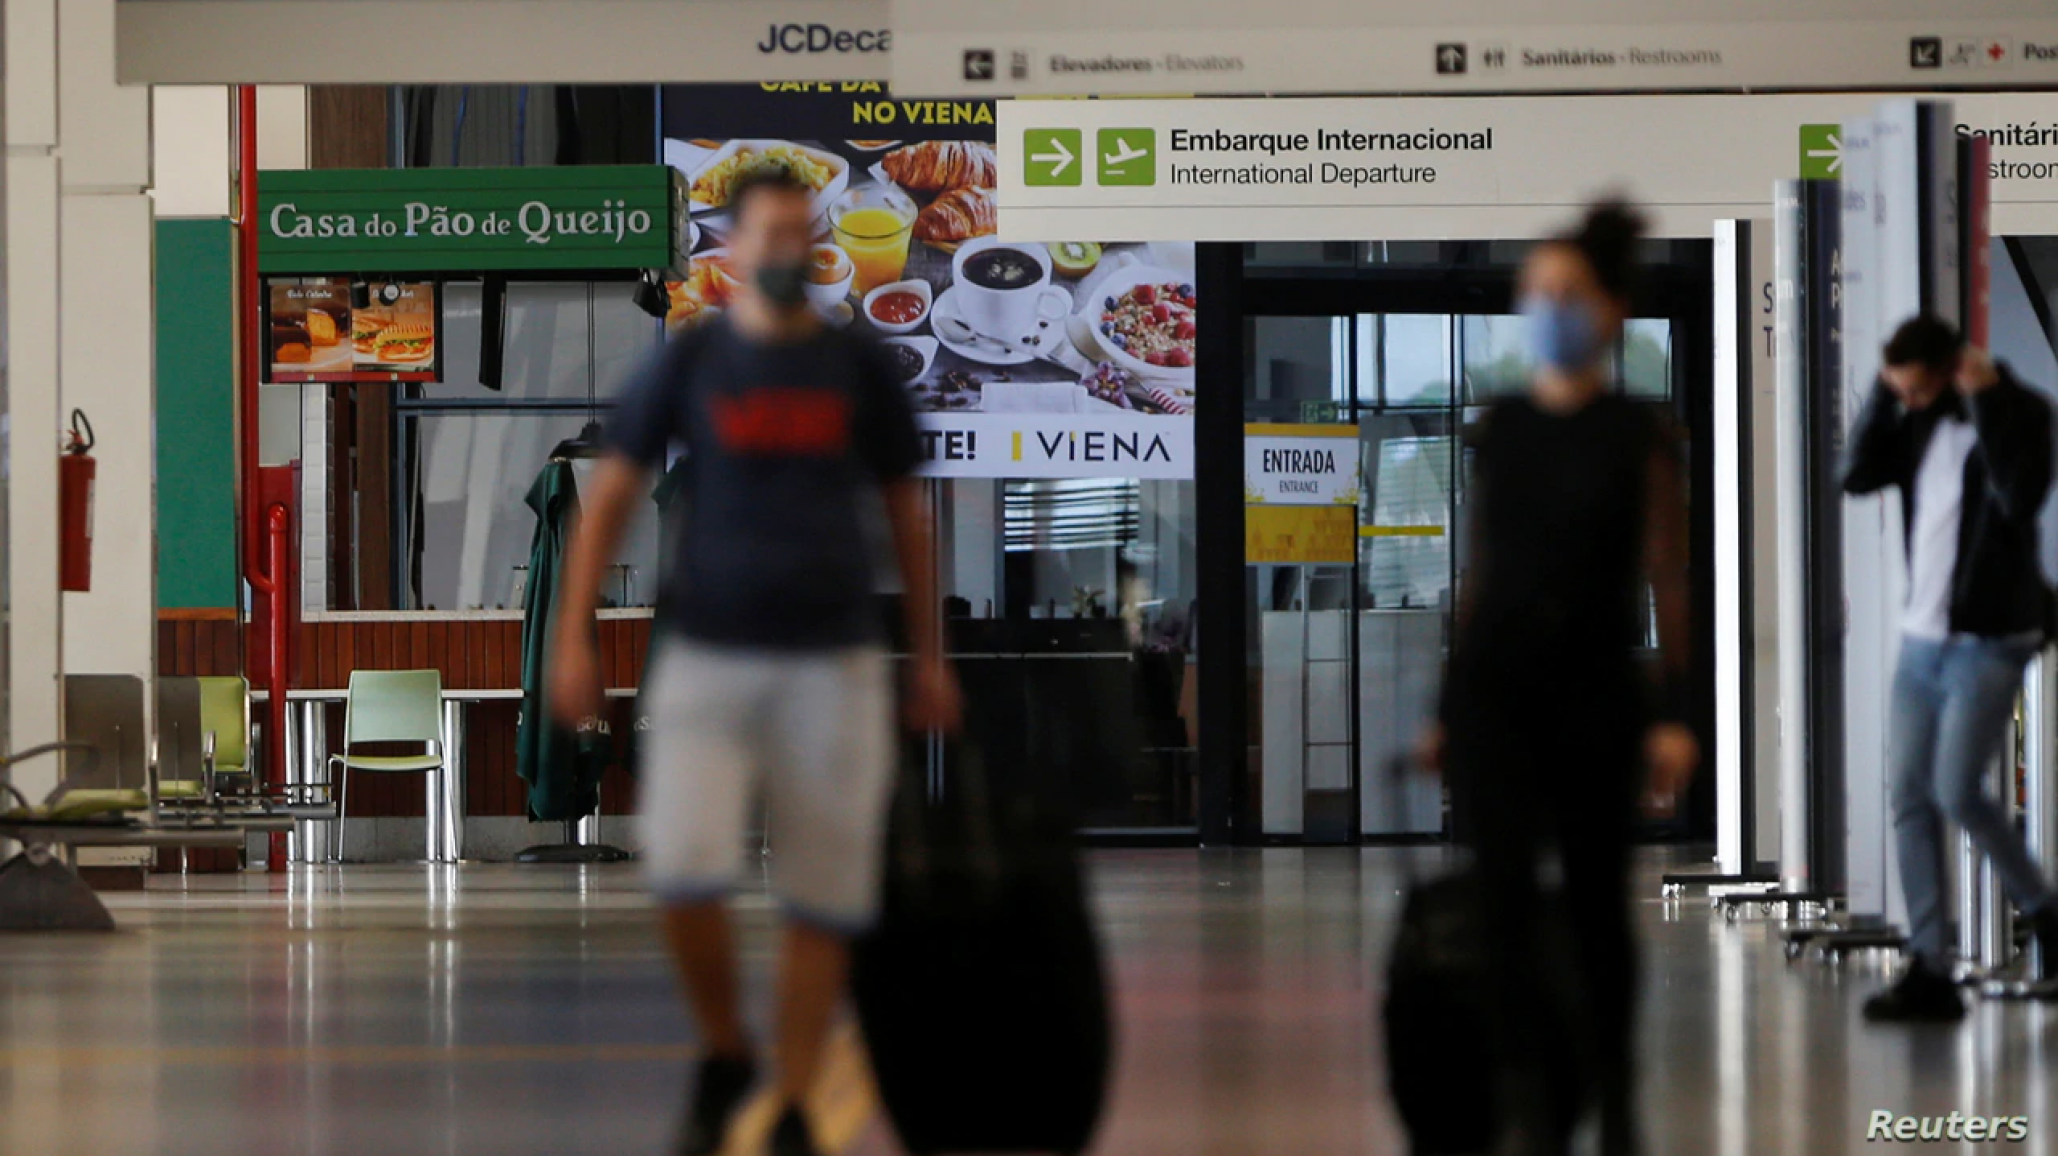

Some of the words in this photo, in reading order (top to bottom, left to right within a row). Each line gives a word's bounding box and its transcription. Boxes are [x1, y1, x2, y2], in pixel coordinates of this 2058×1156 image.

[1050, 54, 1152, 72] Elevadores
[1164, 54, 1244, 71] Elevators
[1523, 47, 1615, 67] Sanitários
[1629, 48, 1722, 65] Restrooms
[853, 101, 896, 124] NO
[902, 101, 994, 124] VIENA
[1171, 129, 1309, 156] Embarque
[1318, 128, 1492, 150] Internacional
[1171, 163, 1313, 184] International
[1321, 163, 1436, 188] Departure
[270, 202, 358, 238] Casa
[365, 212, 397, 238] do
[404, 202, 475, 237] Pão
[481, 209, 511, 236] de
[518, 200, 651, 244] Queijo
[1263, 449, 1336, 473] ENTRADA
[1279, 480, 1319, 494] ENTRANCE
